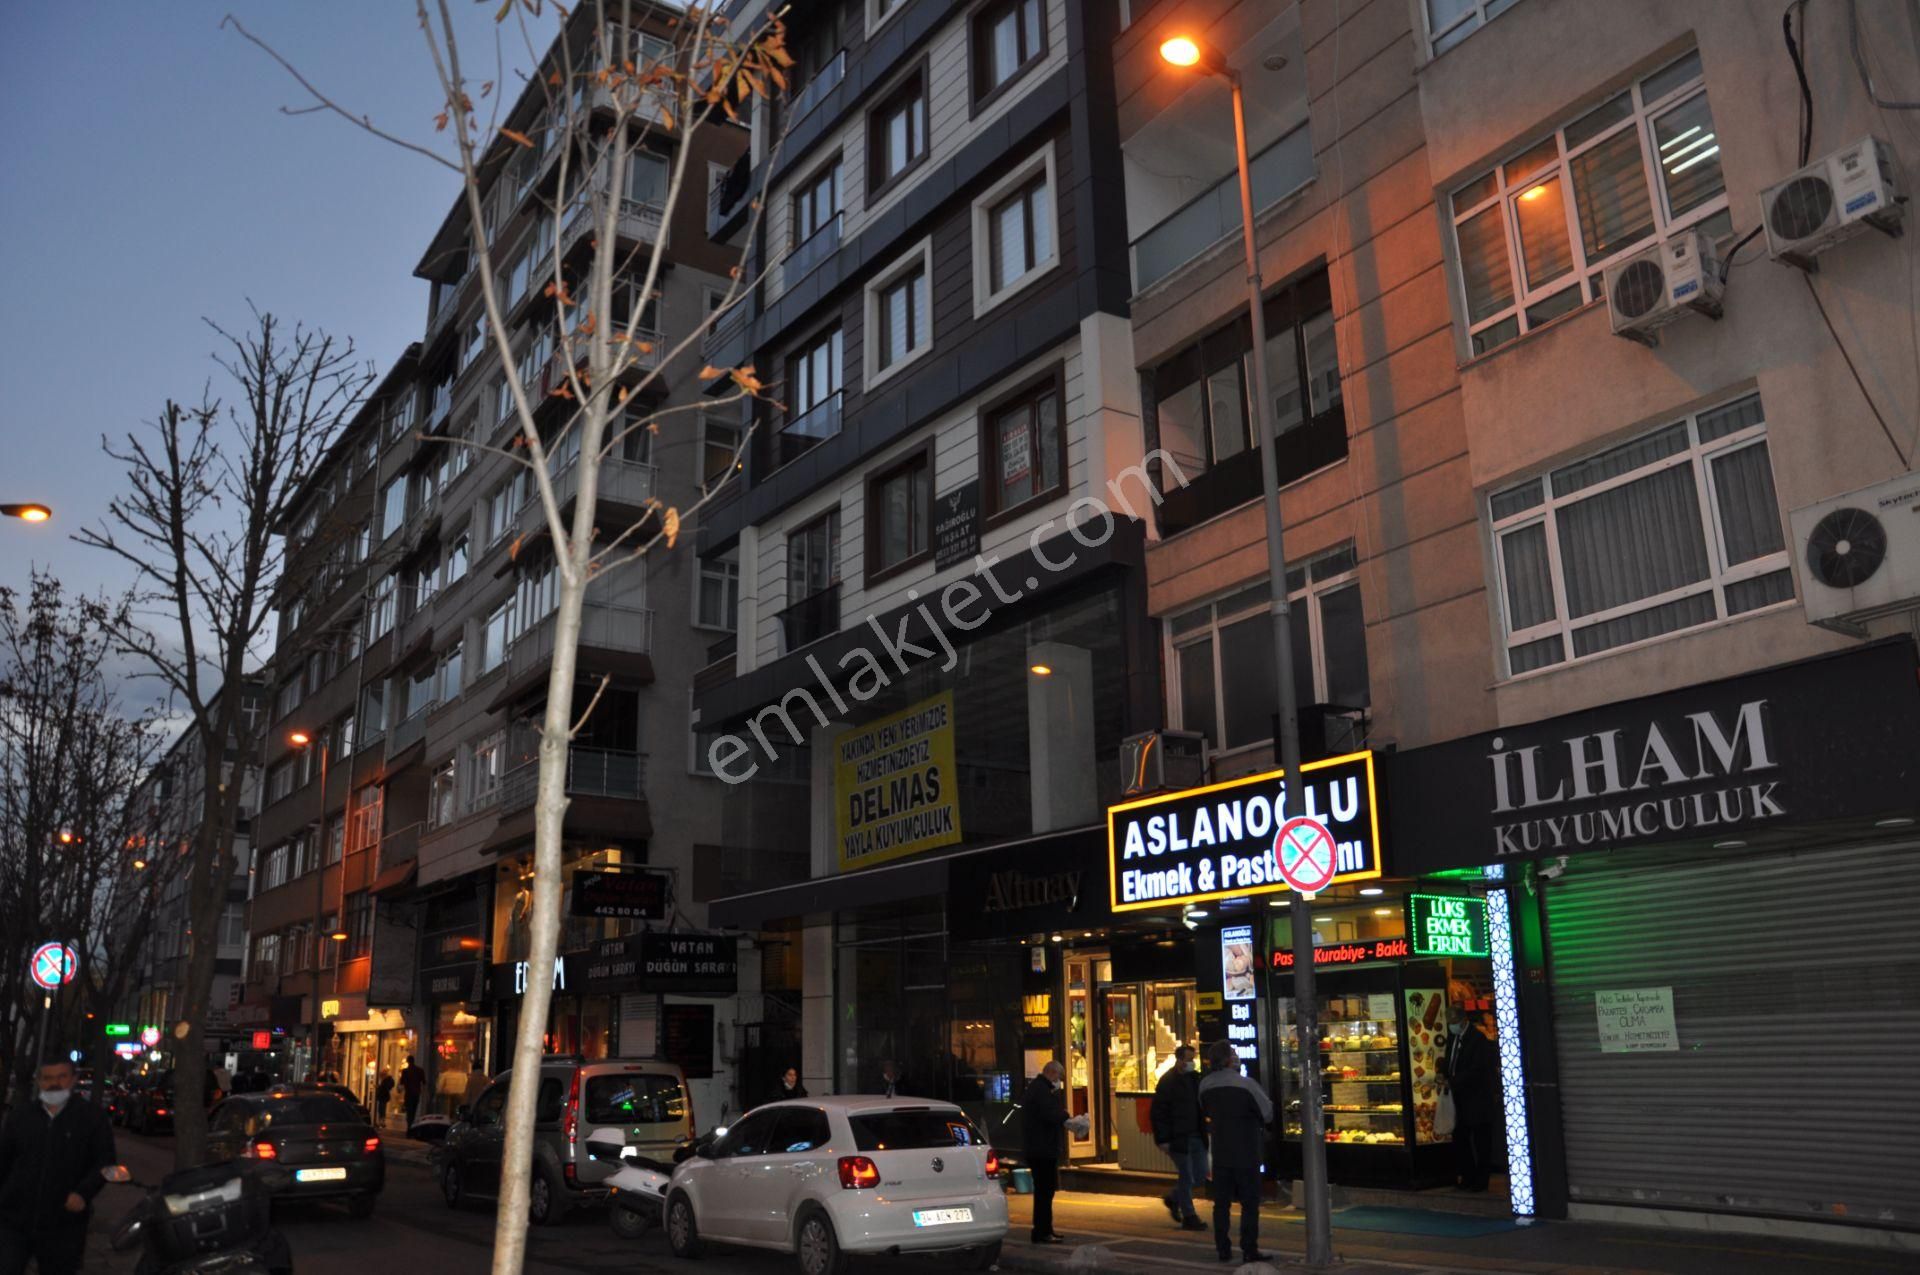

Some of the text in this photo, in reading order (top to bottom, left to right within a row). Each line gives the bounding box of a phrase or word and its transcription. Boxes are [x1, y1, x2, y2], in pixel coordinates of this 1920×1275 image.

[841, 734, 875, 762] YAKINDA
[900, 704, 947, 740] YERİMİZDE
[1487, 699, 1779, 814] İLHAM
[850, 766, 940, 828] DELMAS
[1493, 782, 1786, 855] KUYUMCULUK
[844, 806, 953, 859] YAYLA KUYUMCULUK
[1123, 856, 1193, 902] Ekmek
[1198, 859, 1216, 891] &
[1431, 897, 1465, 919] LÜKS
[1426, 917, 1472, 936] EKMEK
[670, 941, 714, 954] VATAN
[1314, 945, 1365, 963] Kurabiye
[1428, 934, 1472, 953] FIRINI
[646, 958, 688, 974] DÜĞÜN
[1022, 994, 1049, 1014] WU
